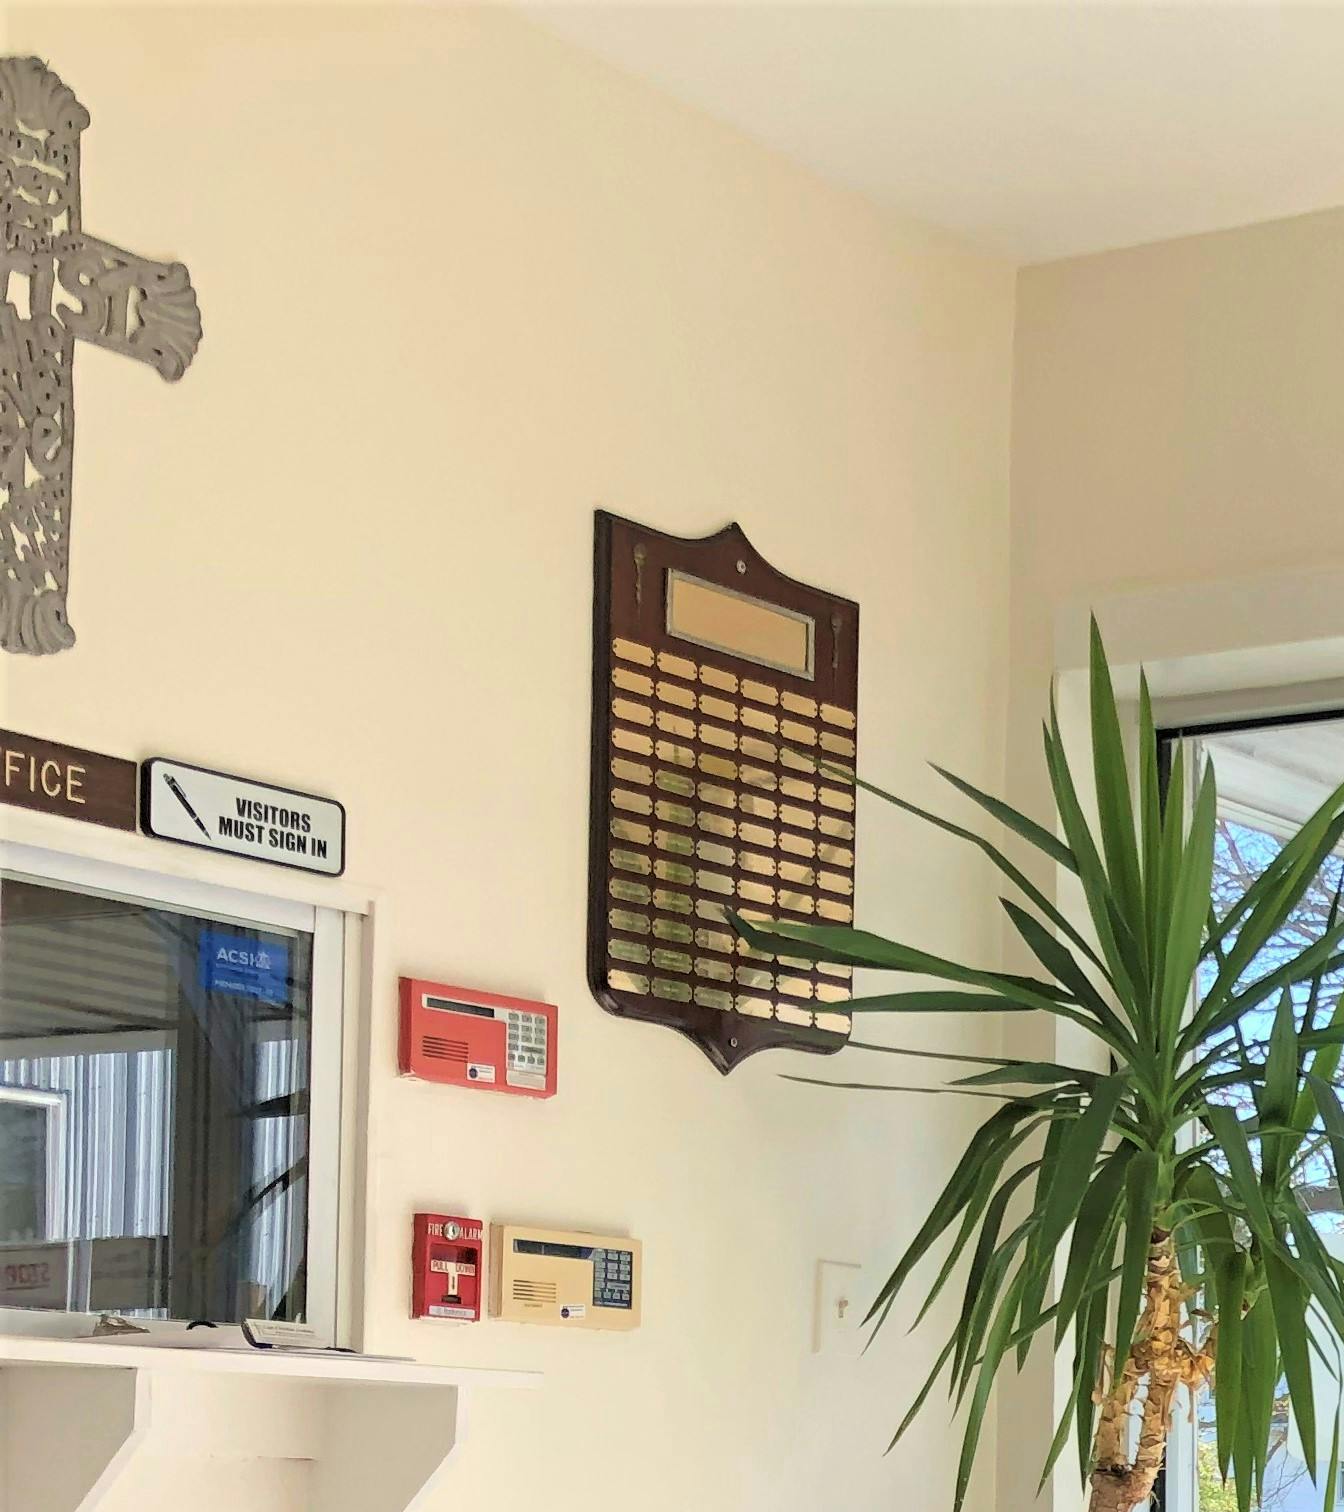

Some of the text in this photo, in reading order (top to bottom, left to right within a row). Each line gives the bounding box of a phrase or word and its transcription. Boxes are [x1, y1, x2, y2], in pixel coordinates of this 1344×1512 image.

[235, 797, 312, 833] VISITORS
[218, 816, 328, 859] MUST SIGN IN
[216, 947, 255, 967] ACSI
[428, 1223, 443, 1236] FIRE
